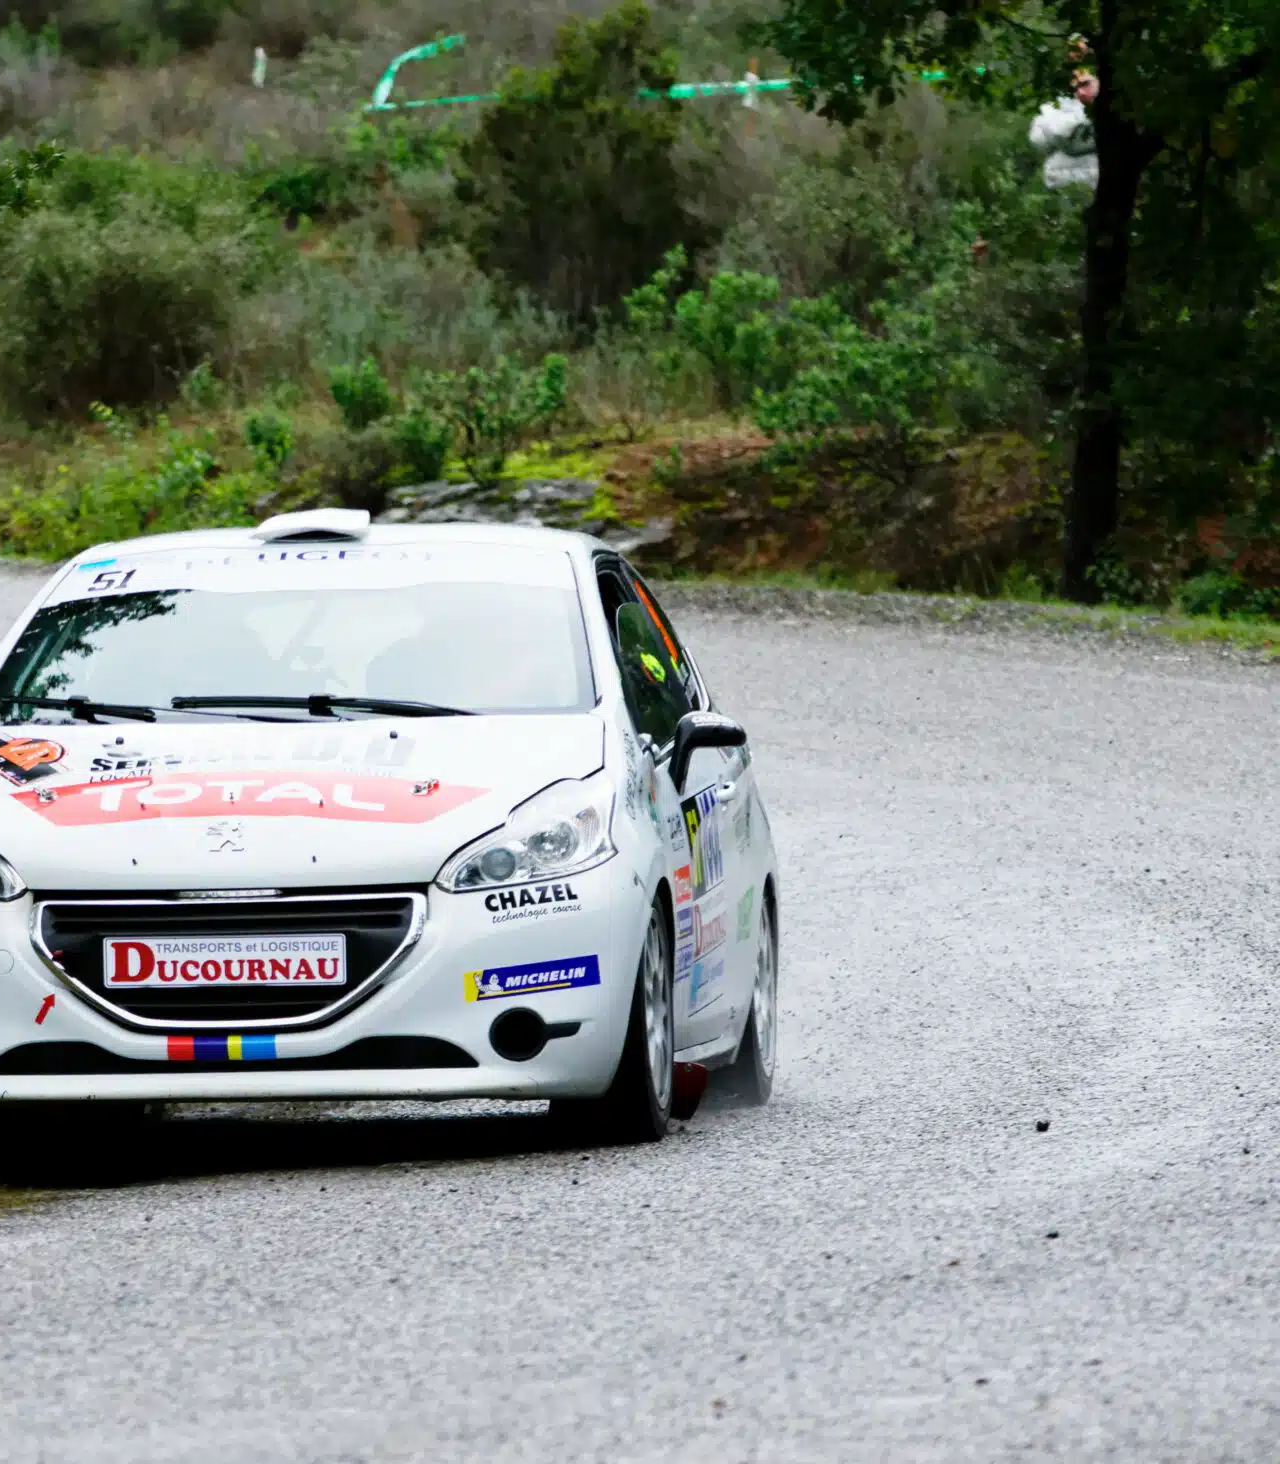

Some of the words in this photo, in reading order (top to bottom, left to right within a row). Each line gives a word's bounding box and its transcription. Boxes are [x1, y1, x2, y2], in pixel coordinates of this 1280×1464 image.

[88, 569, 137, 591] 51
[84, 779, 385, 812] TOTAL
[484, 883, 578, 912] CHAZEL
[492, 908, 548, 924] technologie
[552, 904, 582, 912] course
[157, 943, 242, 954] TRANSPORTS
[246, 943, 257, 953] et
[261, 940, 339, 952] LOGISTIQUE
[111, 941, 340, 982] DUCOURNAU
[505, 967, 586, 988] MICHELIN
